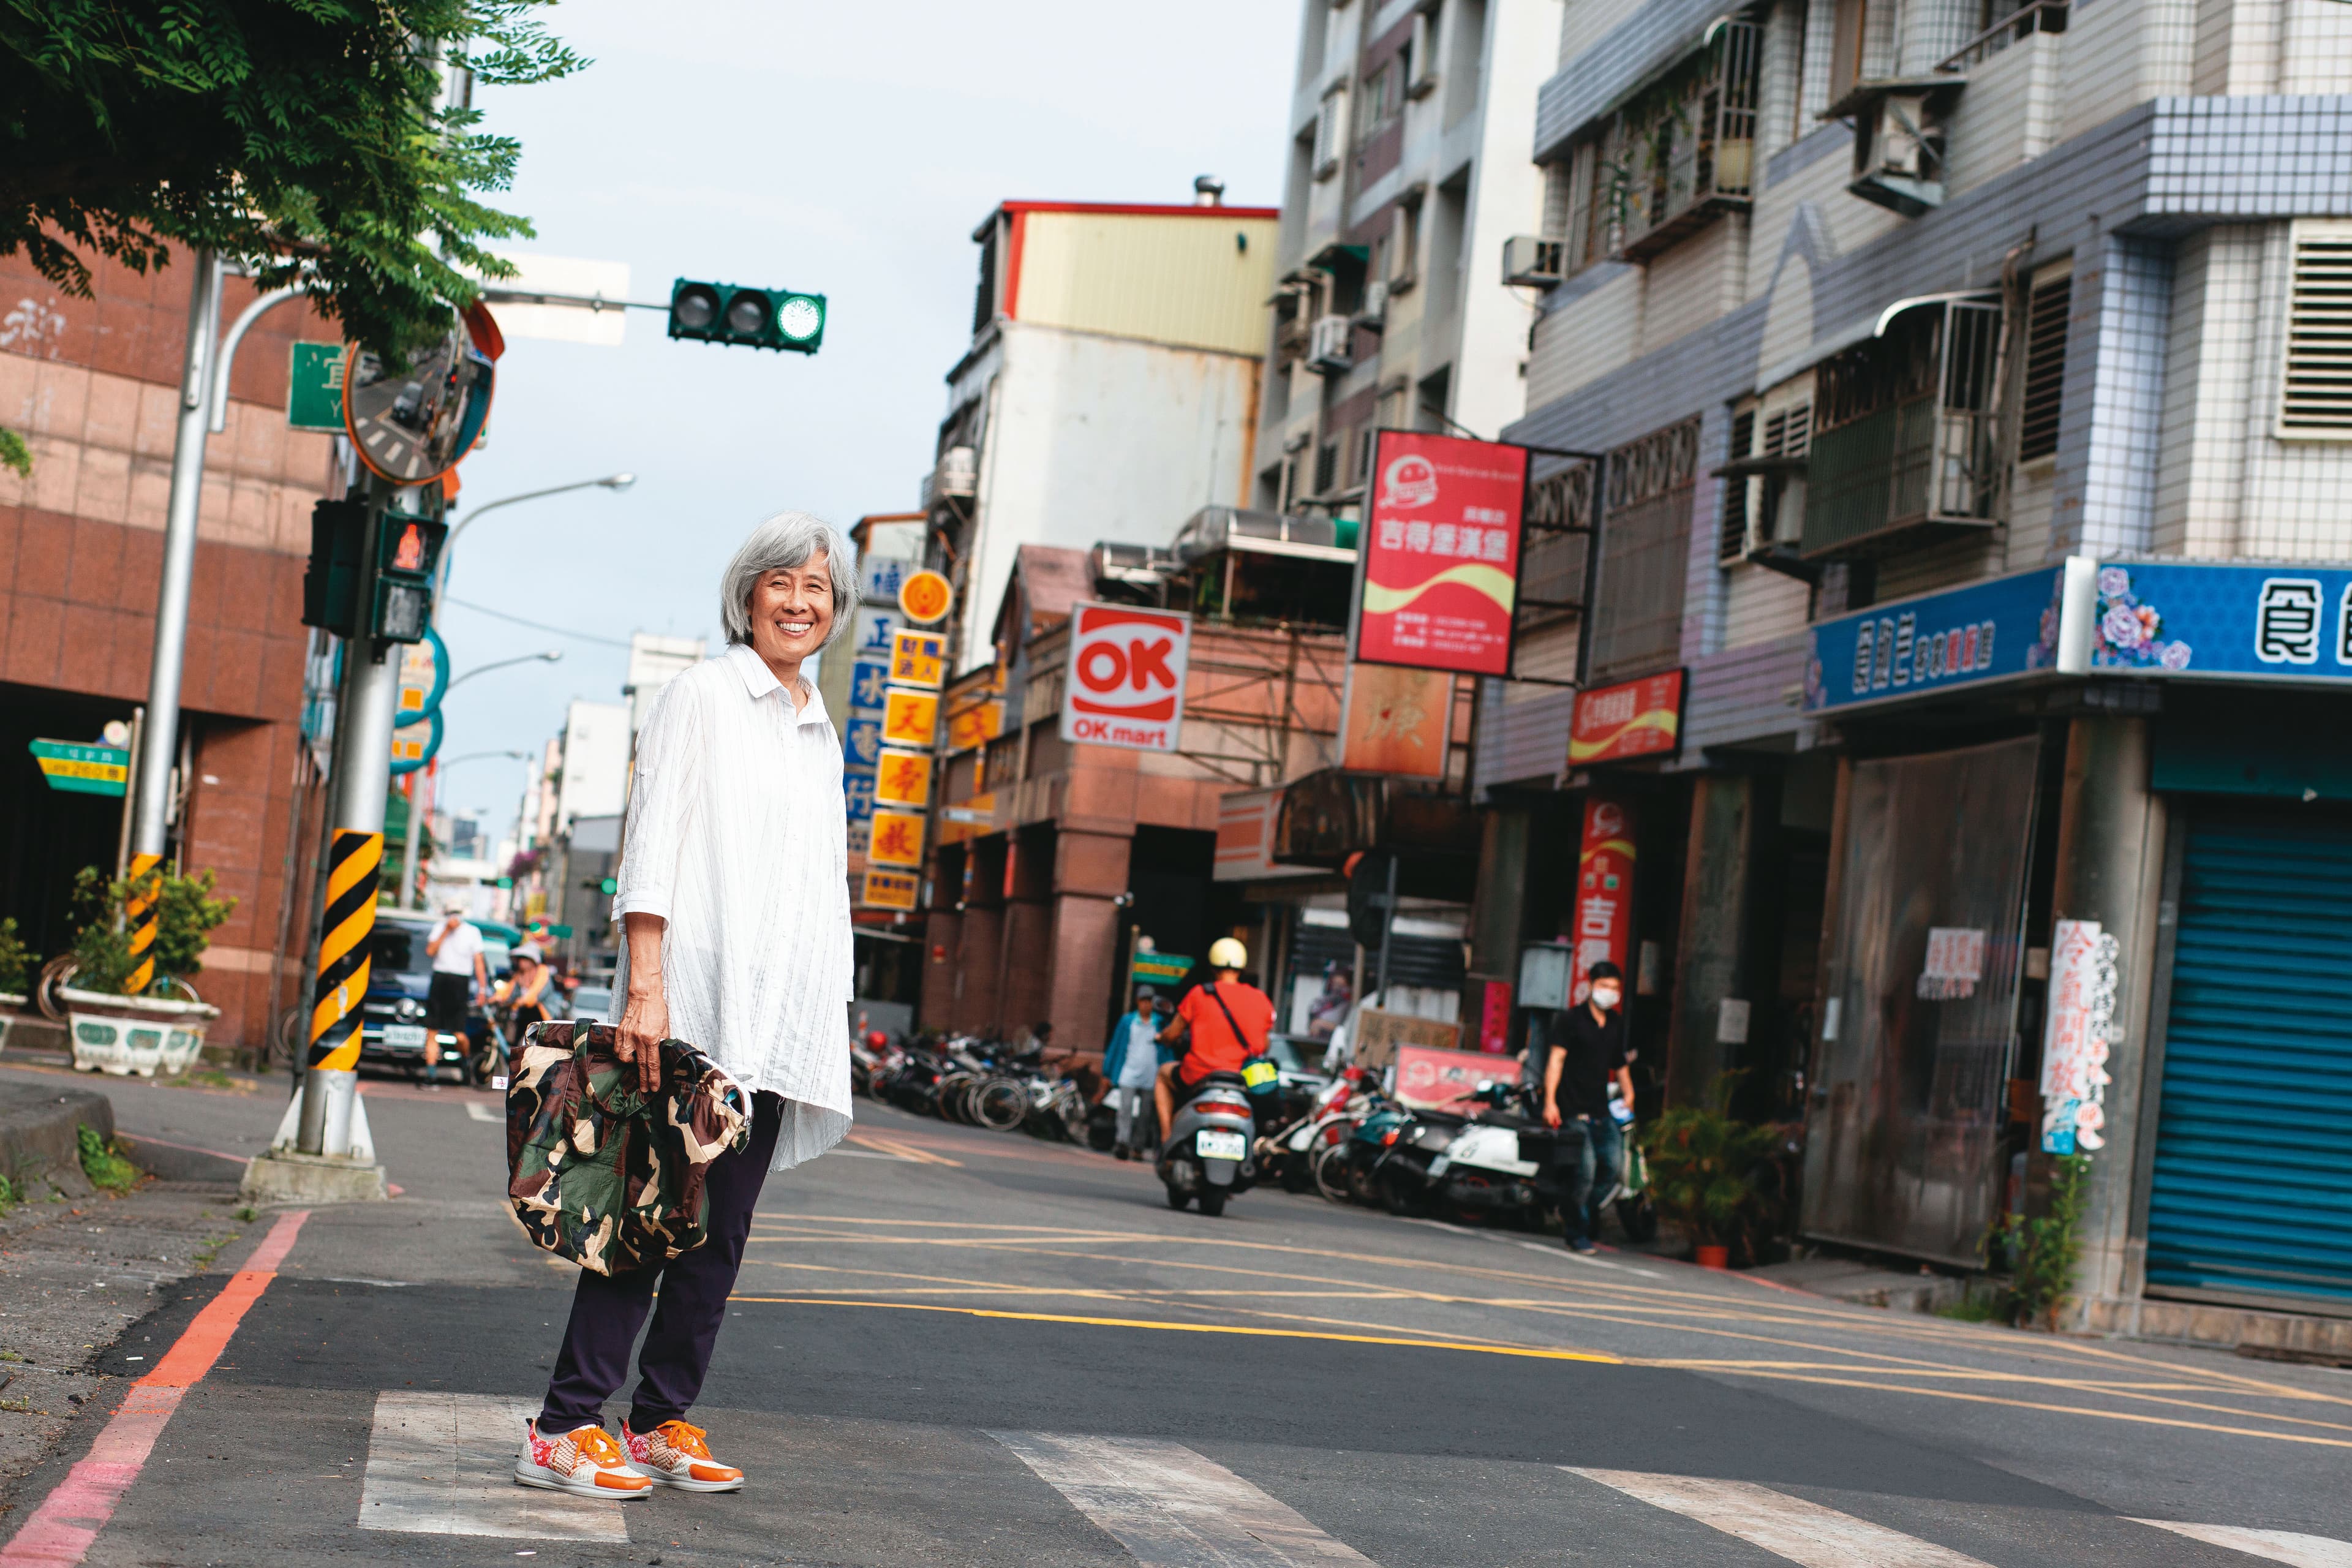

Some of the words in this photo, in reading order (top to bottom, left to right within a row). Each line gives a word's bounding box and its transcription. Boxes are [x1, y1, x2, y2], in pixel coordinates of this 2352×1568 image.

[1077, 638, 1177, 694] OK
[1074, 718, 1110, 739] OK
[1112, 727, 1167, 748] mart
